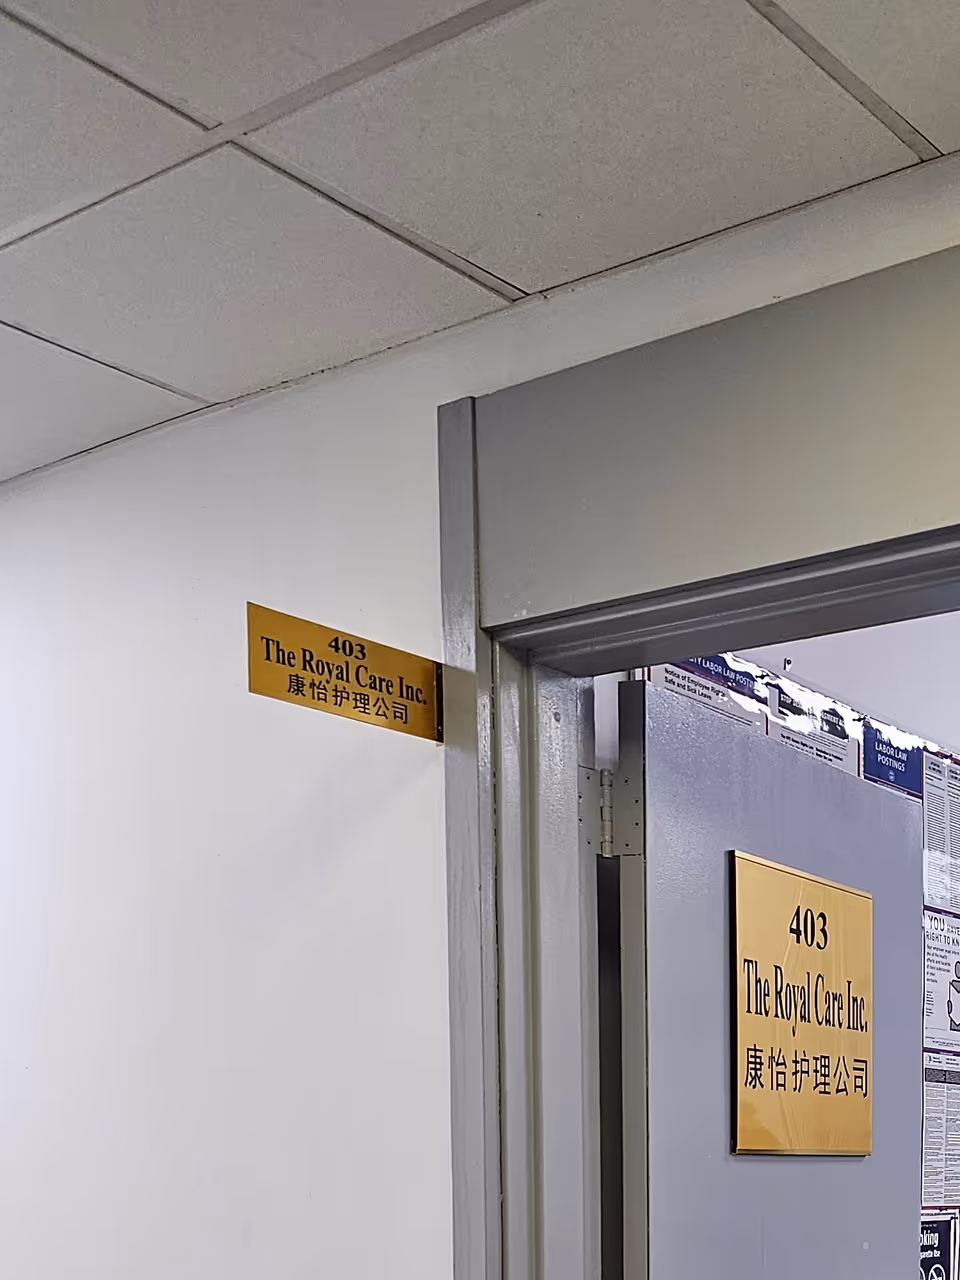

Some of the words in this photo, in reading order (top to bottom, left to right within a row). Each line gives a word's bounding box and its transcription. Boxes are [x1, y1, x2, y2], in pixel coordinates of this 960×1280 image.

[328, 636, 367, 661] 403
[260, 636, 296, 668] The
[301, 648, 350, 685] Royal
[355, 664, 394, 696] Care
[397, 675, 428, 705] Inc.
[703, 658, 723, 675] LABOR
[723, 667, 736, 680] LAW
[664, 676, 676, 686] Safe
[676, 682, 686, 690] and
[686, 685, 697, 694] Sick
[287, 673, 408, 725] 康怡护理公司
[875, 741, 895, 757] LABOR
[895, 749, 908, 761] LAW
[877, 753, 906, 772] POSTINGS
[789, 905, 829, 950] 403
[928, 914, 944, 932] YOU
[946, 923, 960, 936] HAVE
[926, 931, 942, 944] RIGHT
[943, 934, 950, 945] TO
[743, 958, 770, 1017] The
[773, 964, 811, 1037] Royal
[814, 973, 844, 1029] Care
[846, 980, 868, 1033] Inc.
[744, 1044, 868, 1098] 康怡护理公司
[920, 1230, 939, 1247] oking
[920, 1250, 933, 1260] garette
